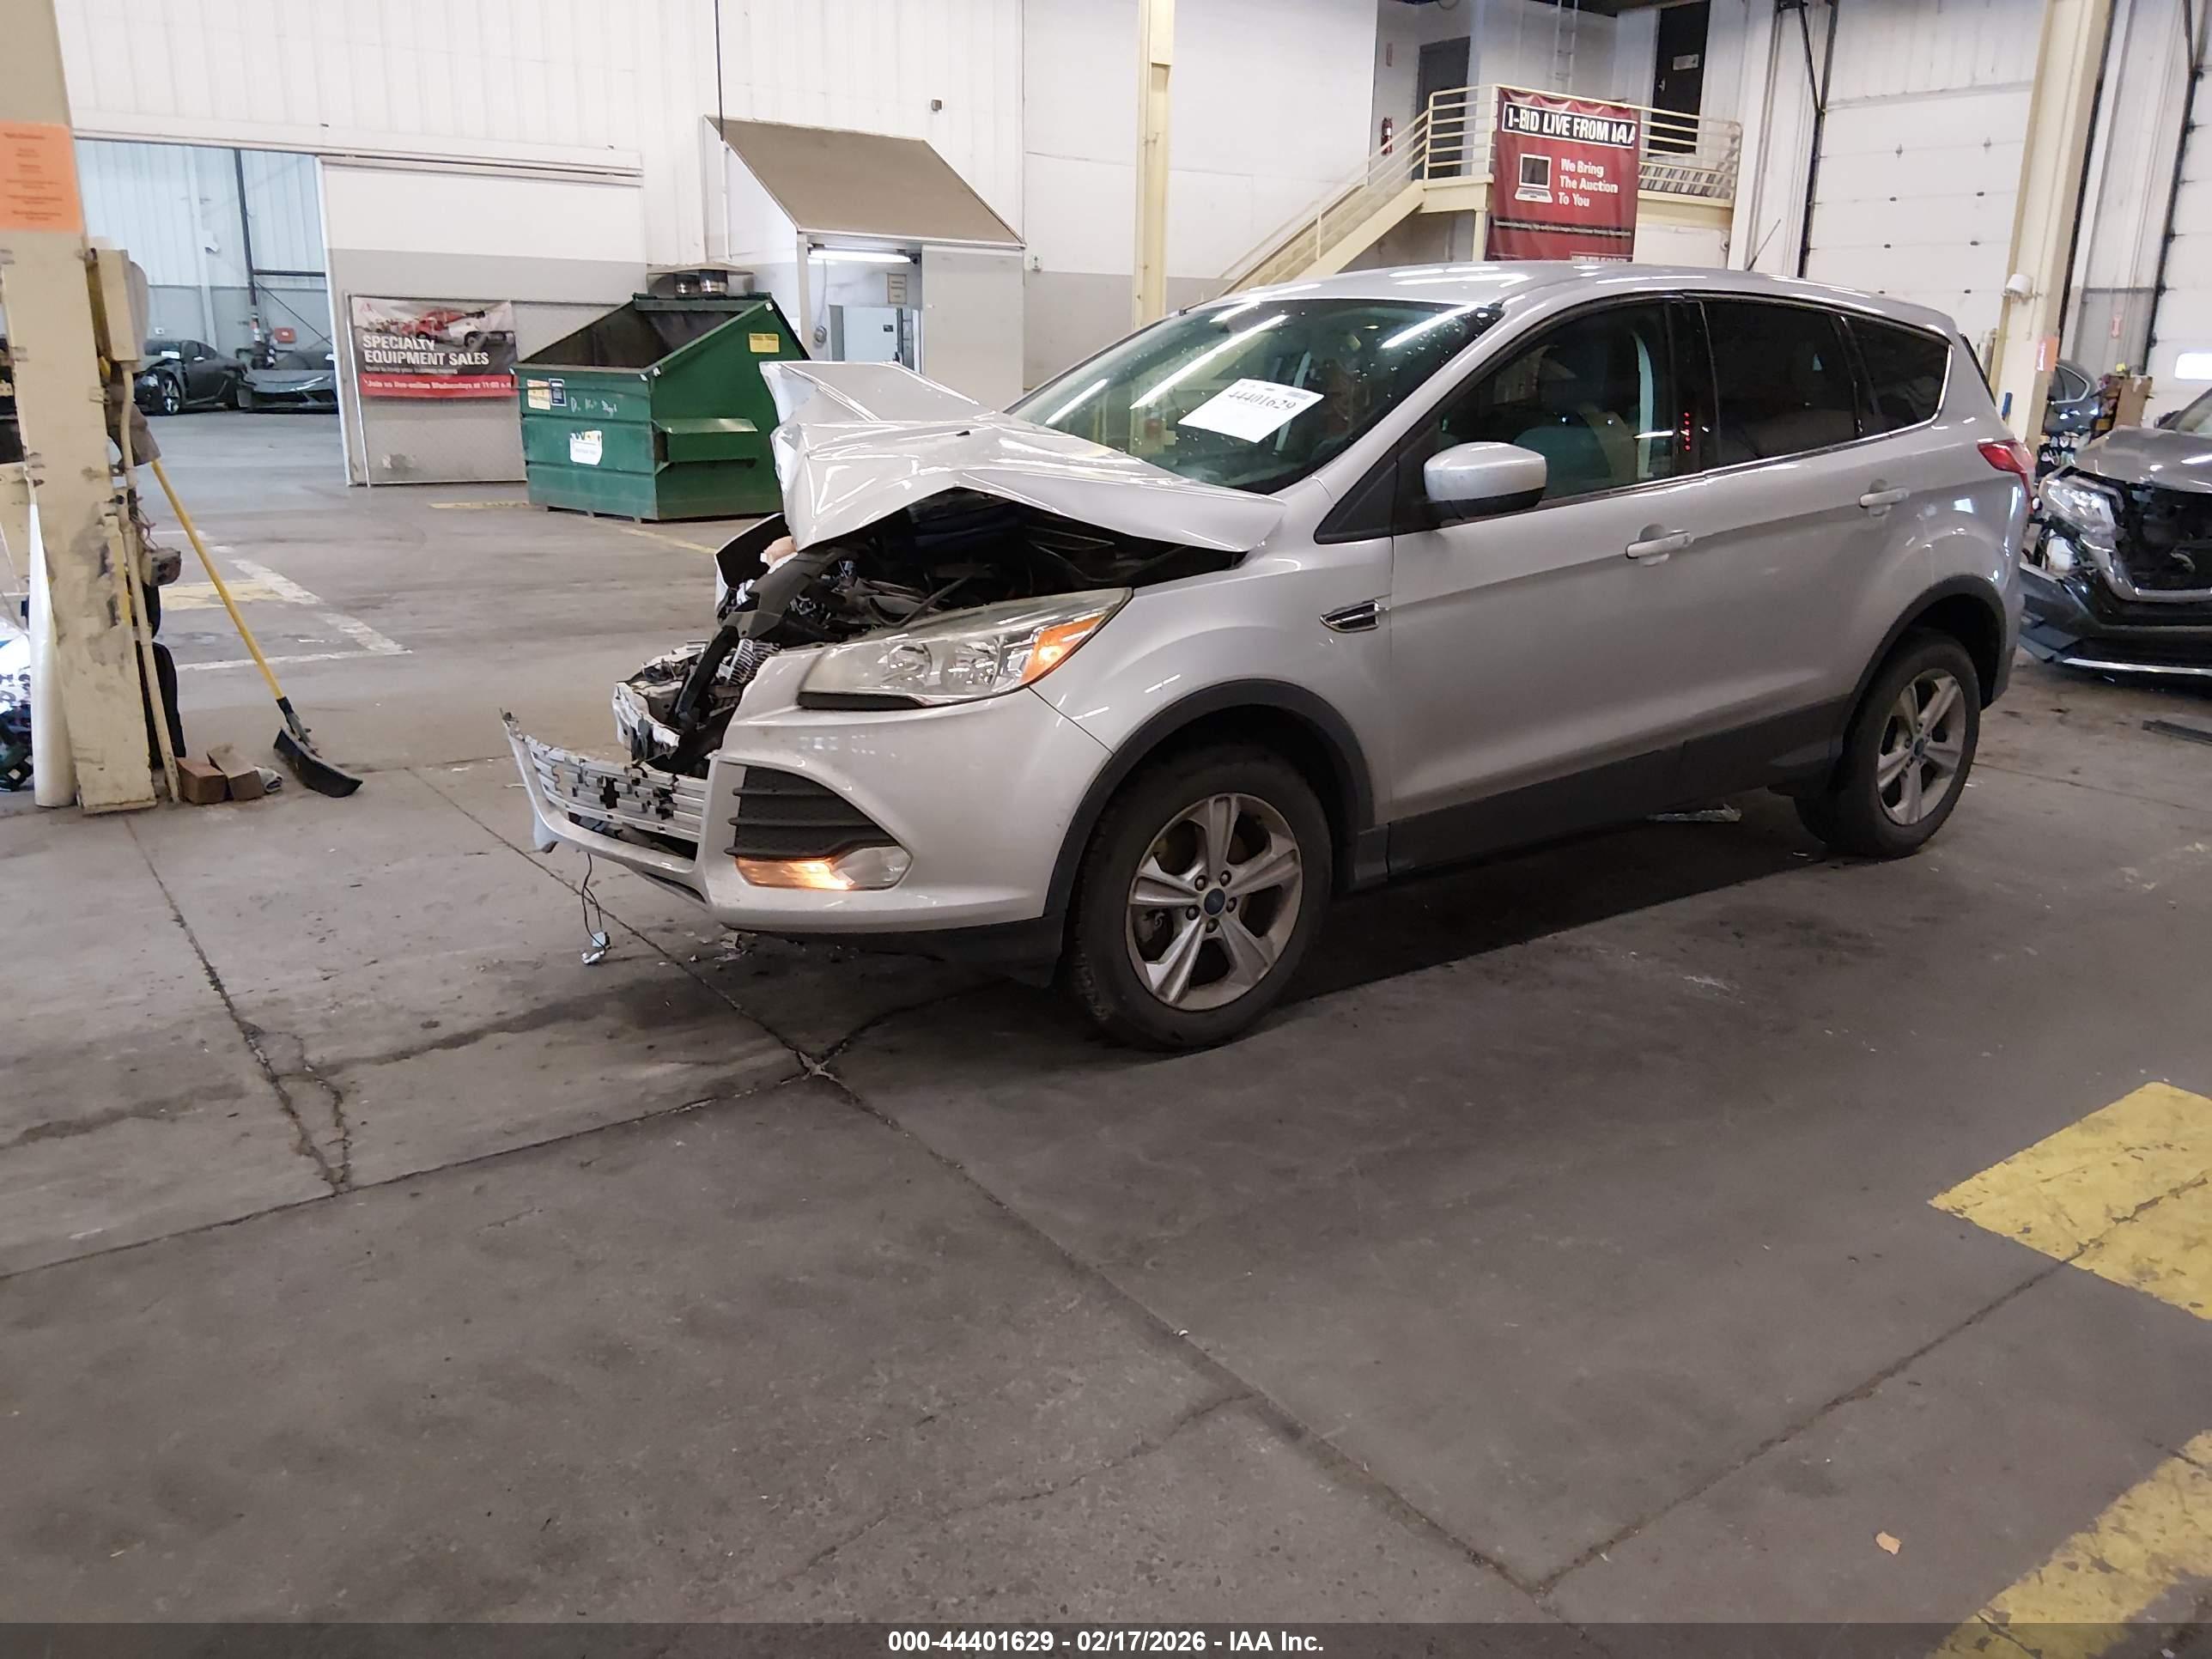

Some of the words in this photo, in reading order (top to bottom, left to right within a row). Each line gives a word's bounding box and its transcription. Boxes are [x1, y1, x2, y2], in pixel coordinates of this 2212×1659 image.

[1508, 107, 1540, 132] I-BID
[1543, 112, 1572, 137] LIVE
[1573, 117, 1608, 143] FROM
[1560, 158, 1576, 172] We
[1577, 160, 1604, 177] Bring
[1559, 175, 1577, 190] The
[1578, 179, 1619, 194] Auction
[1558, 192, 1570, 205] To
[1571, 193, 1590, 207] You
[363, 335, 435, 351] SPECIALTY
[364, 350, 446, 366] EQUIPMENT
[449, 351, 489, 366] SALES
